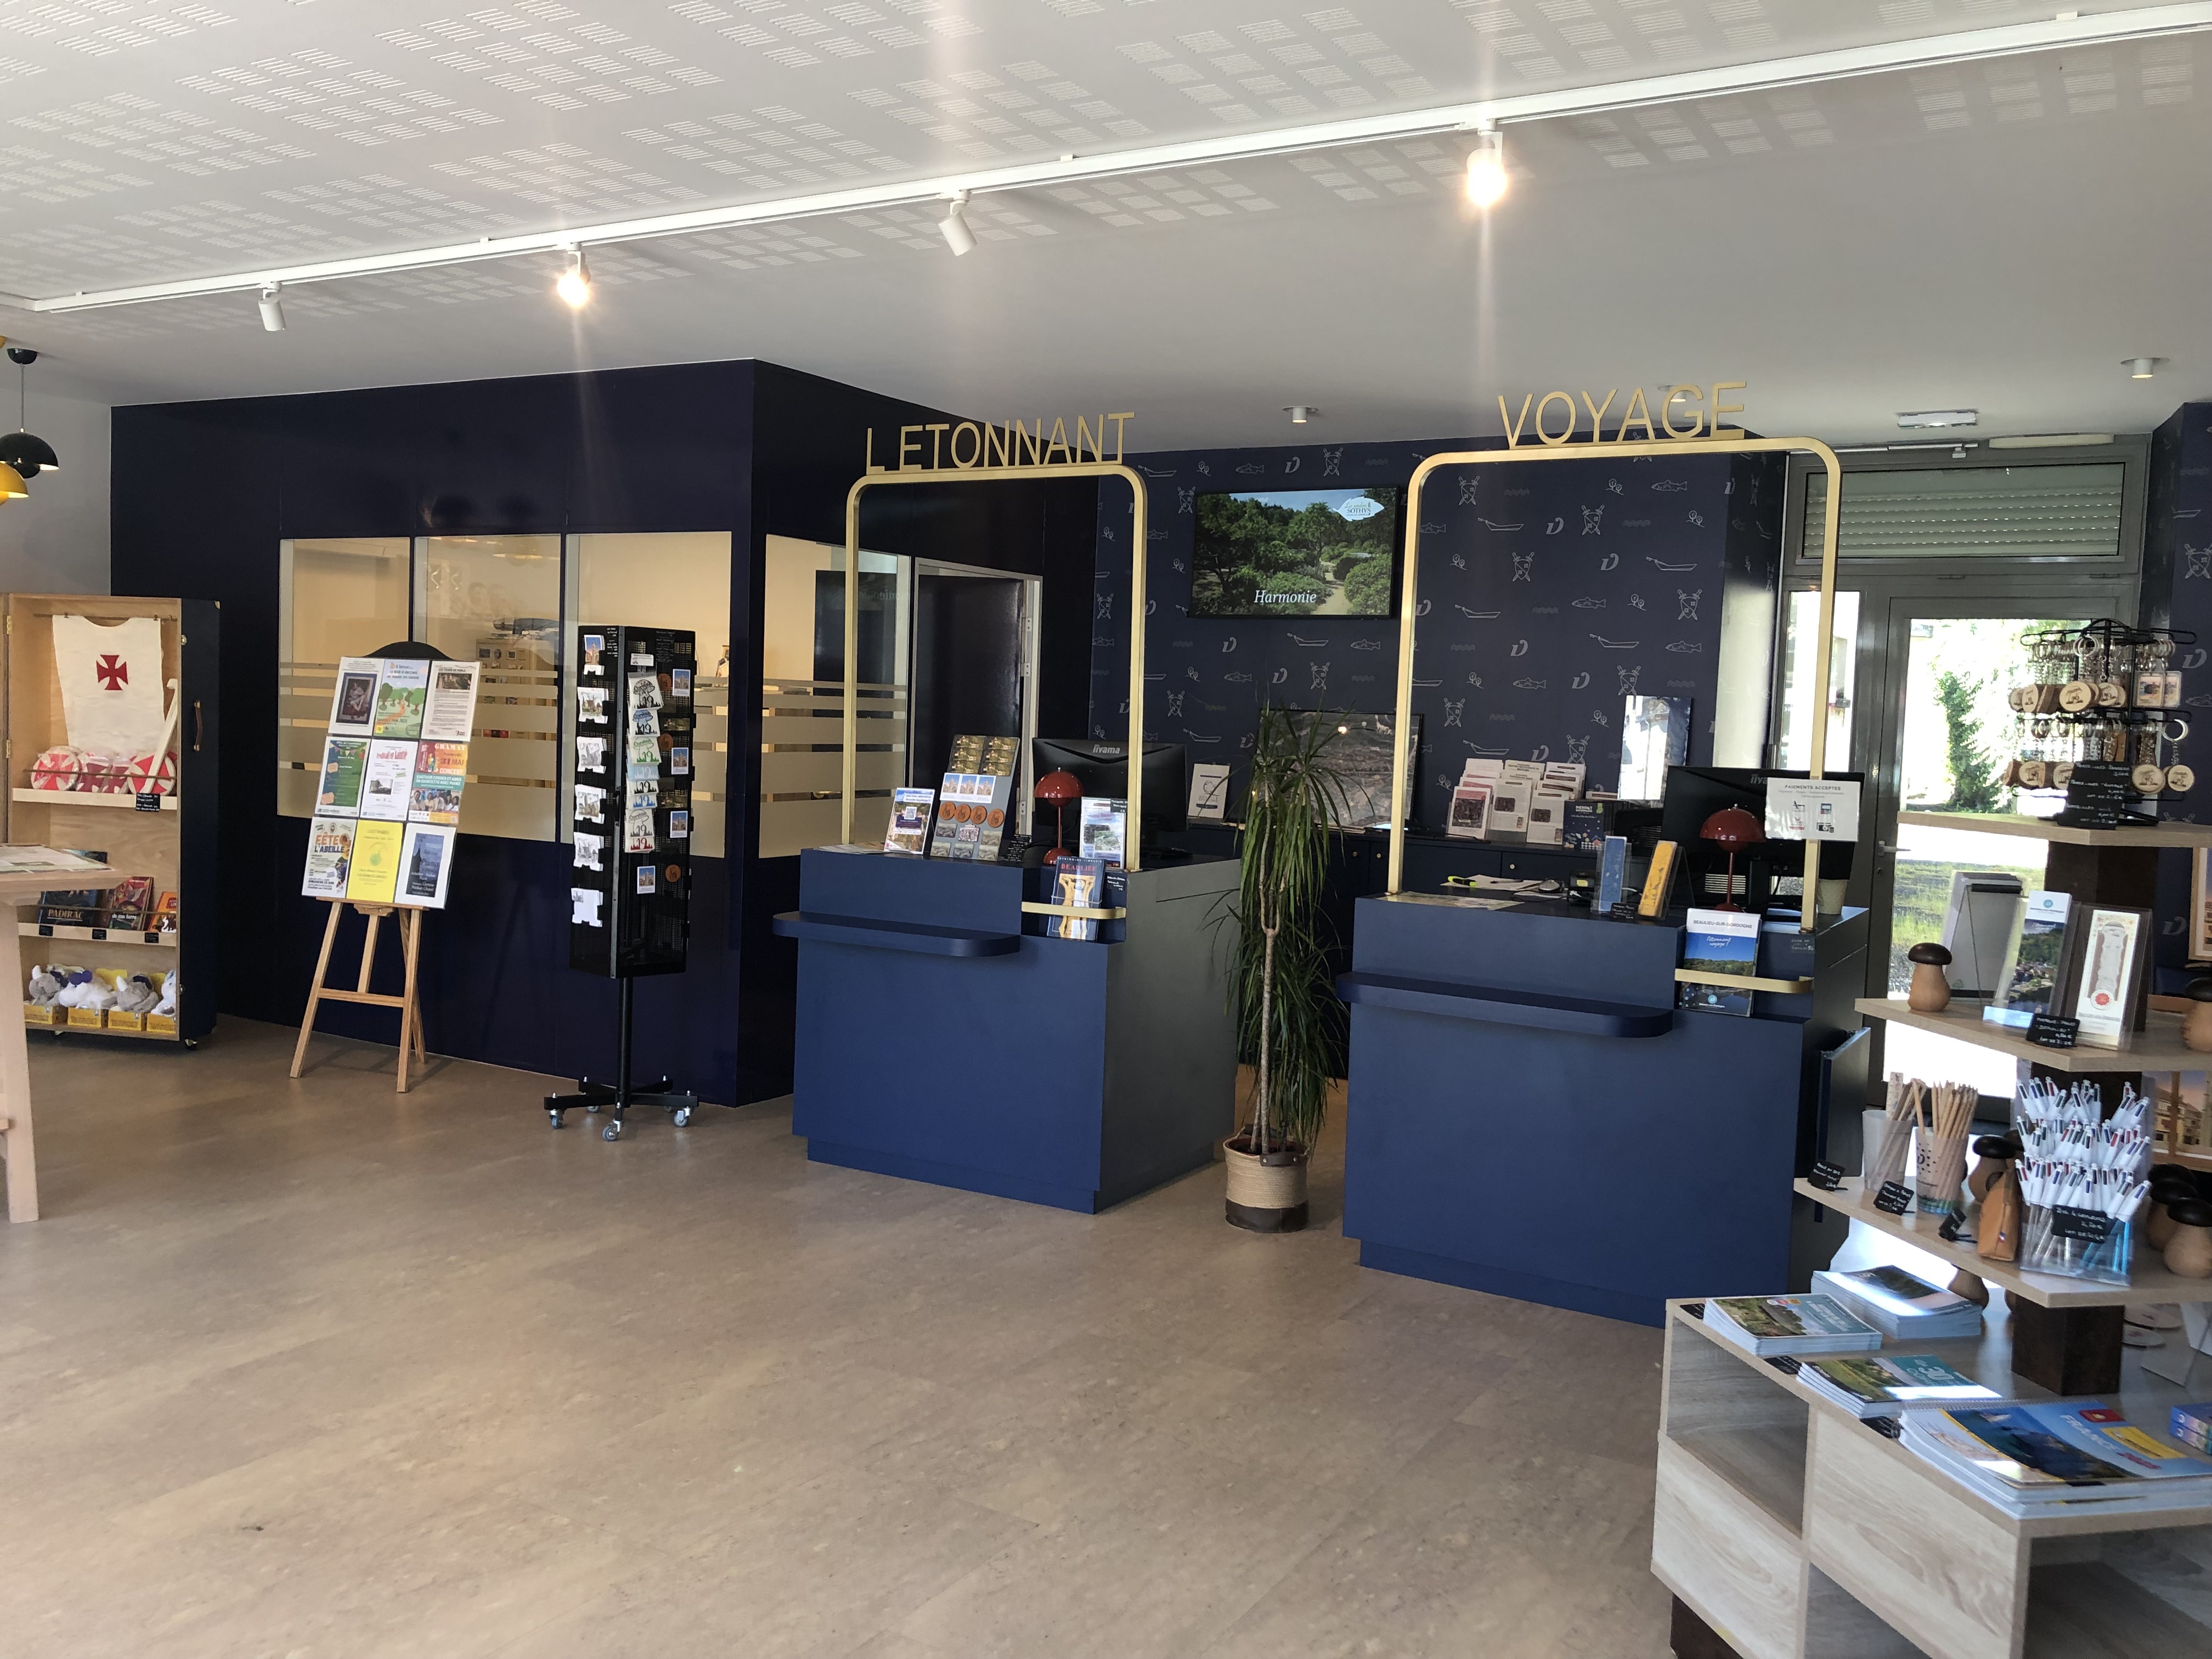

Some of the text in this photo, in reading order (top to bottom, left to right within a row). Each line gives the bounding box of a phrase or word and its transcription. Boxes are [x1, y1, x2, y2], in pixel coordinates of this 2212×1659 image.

[1498, 381, 1747, 450] VOYAGE
[1254, 590, 1317, 603] Harmonie
[1751, 774, 1767, 784] iiya
[315, 832, 340, 845] FÊTE
[314, 845, 345, 853] L'ABEILLE
[48, 909, 84, 919] PADIRAC
[1694, 920, 1753, 928] BEAULIEU-SUR-DORDOGNE
